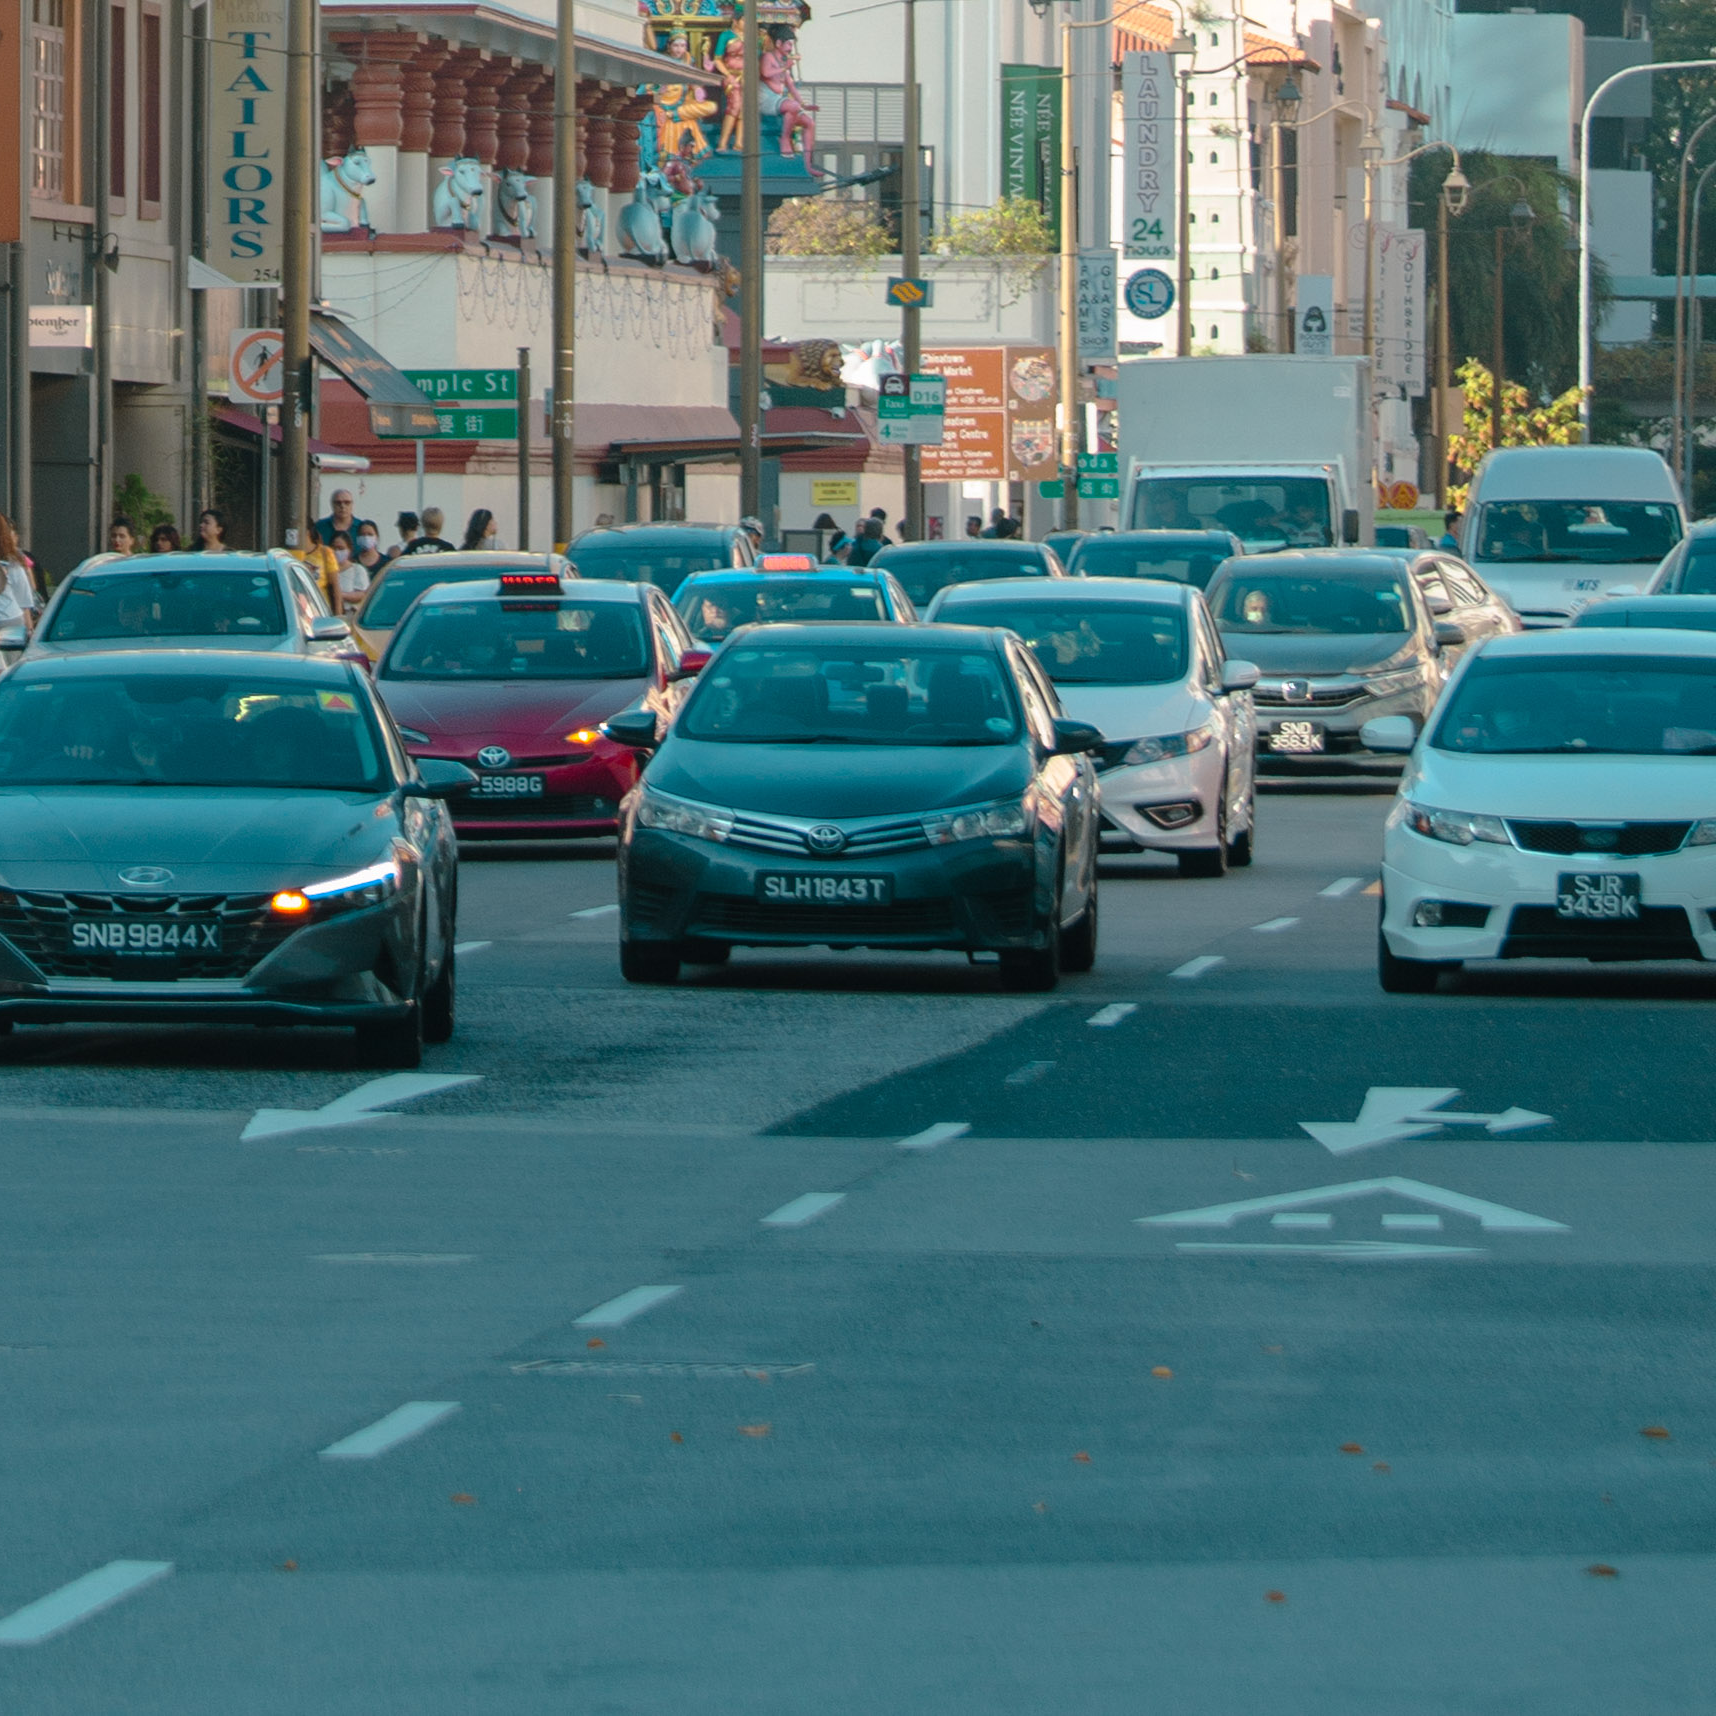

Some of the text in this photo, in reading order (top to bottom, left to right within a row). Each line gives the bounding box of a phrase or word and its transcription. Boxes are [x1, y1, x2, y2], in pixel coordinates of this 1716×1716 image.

[222, 31, 273, 259] TAILORS
[1137, 55, 1159, 213] LAUNDRY
[1010, 133, 1025, 199] VINTA
[1132, 218, 1164, 241] 24
[253, 269, 280, 281] 254
[1100, 265, 1111, 333] GLASS
[416, 372, 509, 397] mple St
[913, 391, 940, 402] D16
[880, 423, 891, 438] 4
[1280, 721, 1312, 735] SND
[481, 775, 543, 792] 5988G
[764, 876, 886, 900] SLH1843T
[1574, 875, 1621, 895] SJR
[1557, 894, 1638, 917] 3439K
[72, 922, 218, 947] SNB9844X
